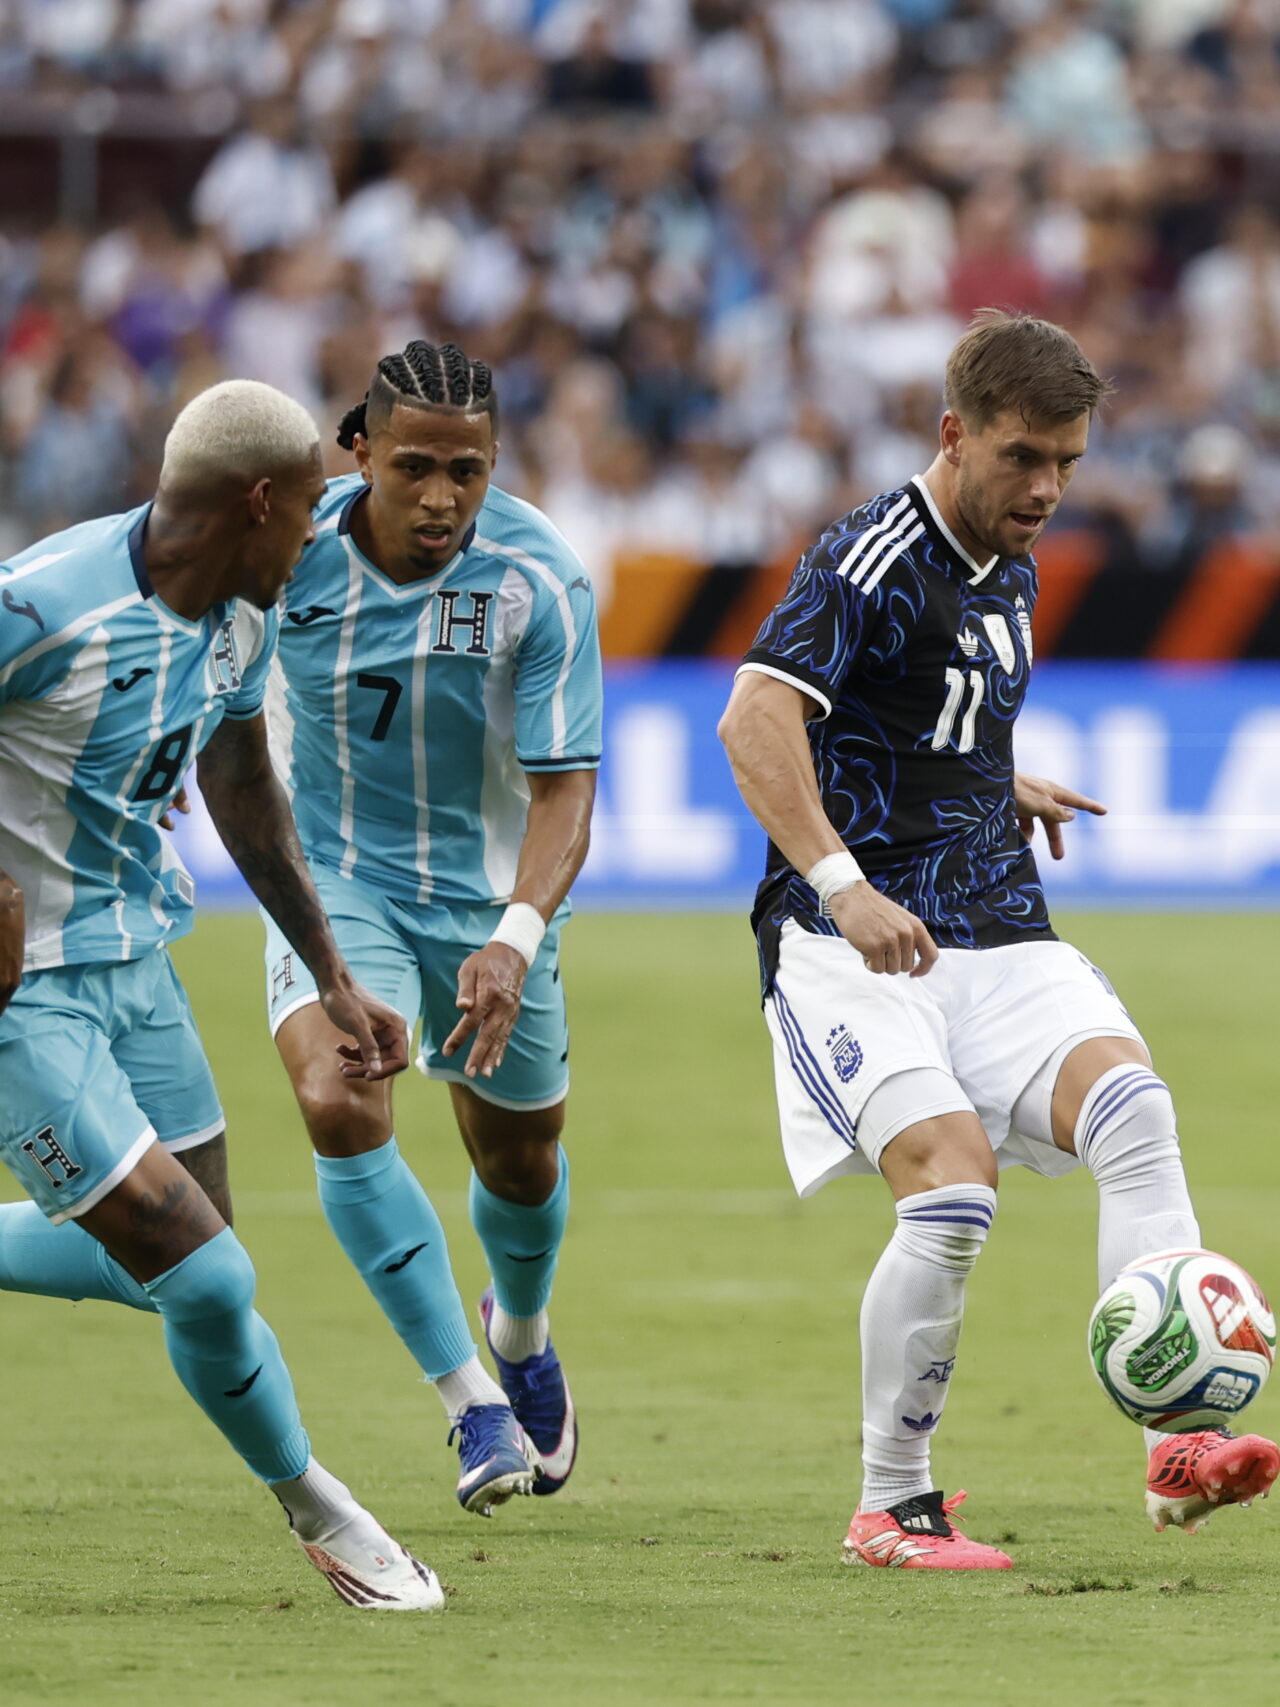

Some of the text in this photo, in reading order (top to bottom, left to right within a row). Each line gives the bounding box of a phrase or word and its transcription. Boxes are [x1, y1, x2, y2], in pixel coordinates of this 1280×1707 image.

[431, 589, 497, 657] H
[357, 672, 403, 741] 7
[931, 667, 985, 754] 11
[132, 722, 194, 802] 8
[21, 1124, 84, 1188] H
[1144, 1347, 1191, 1386] TRIONDA
